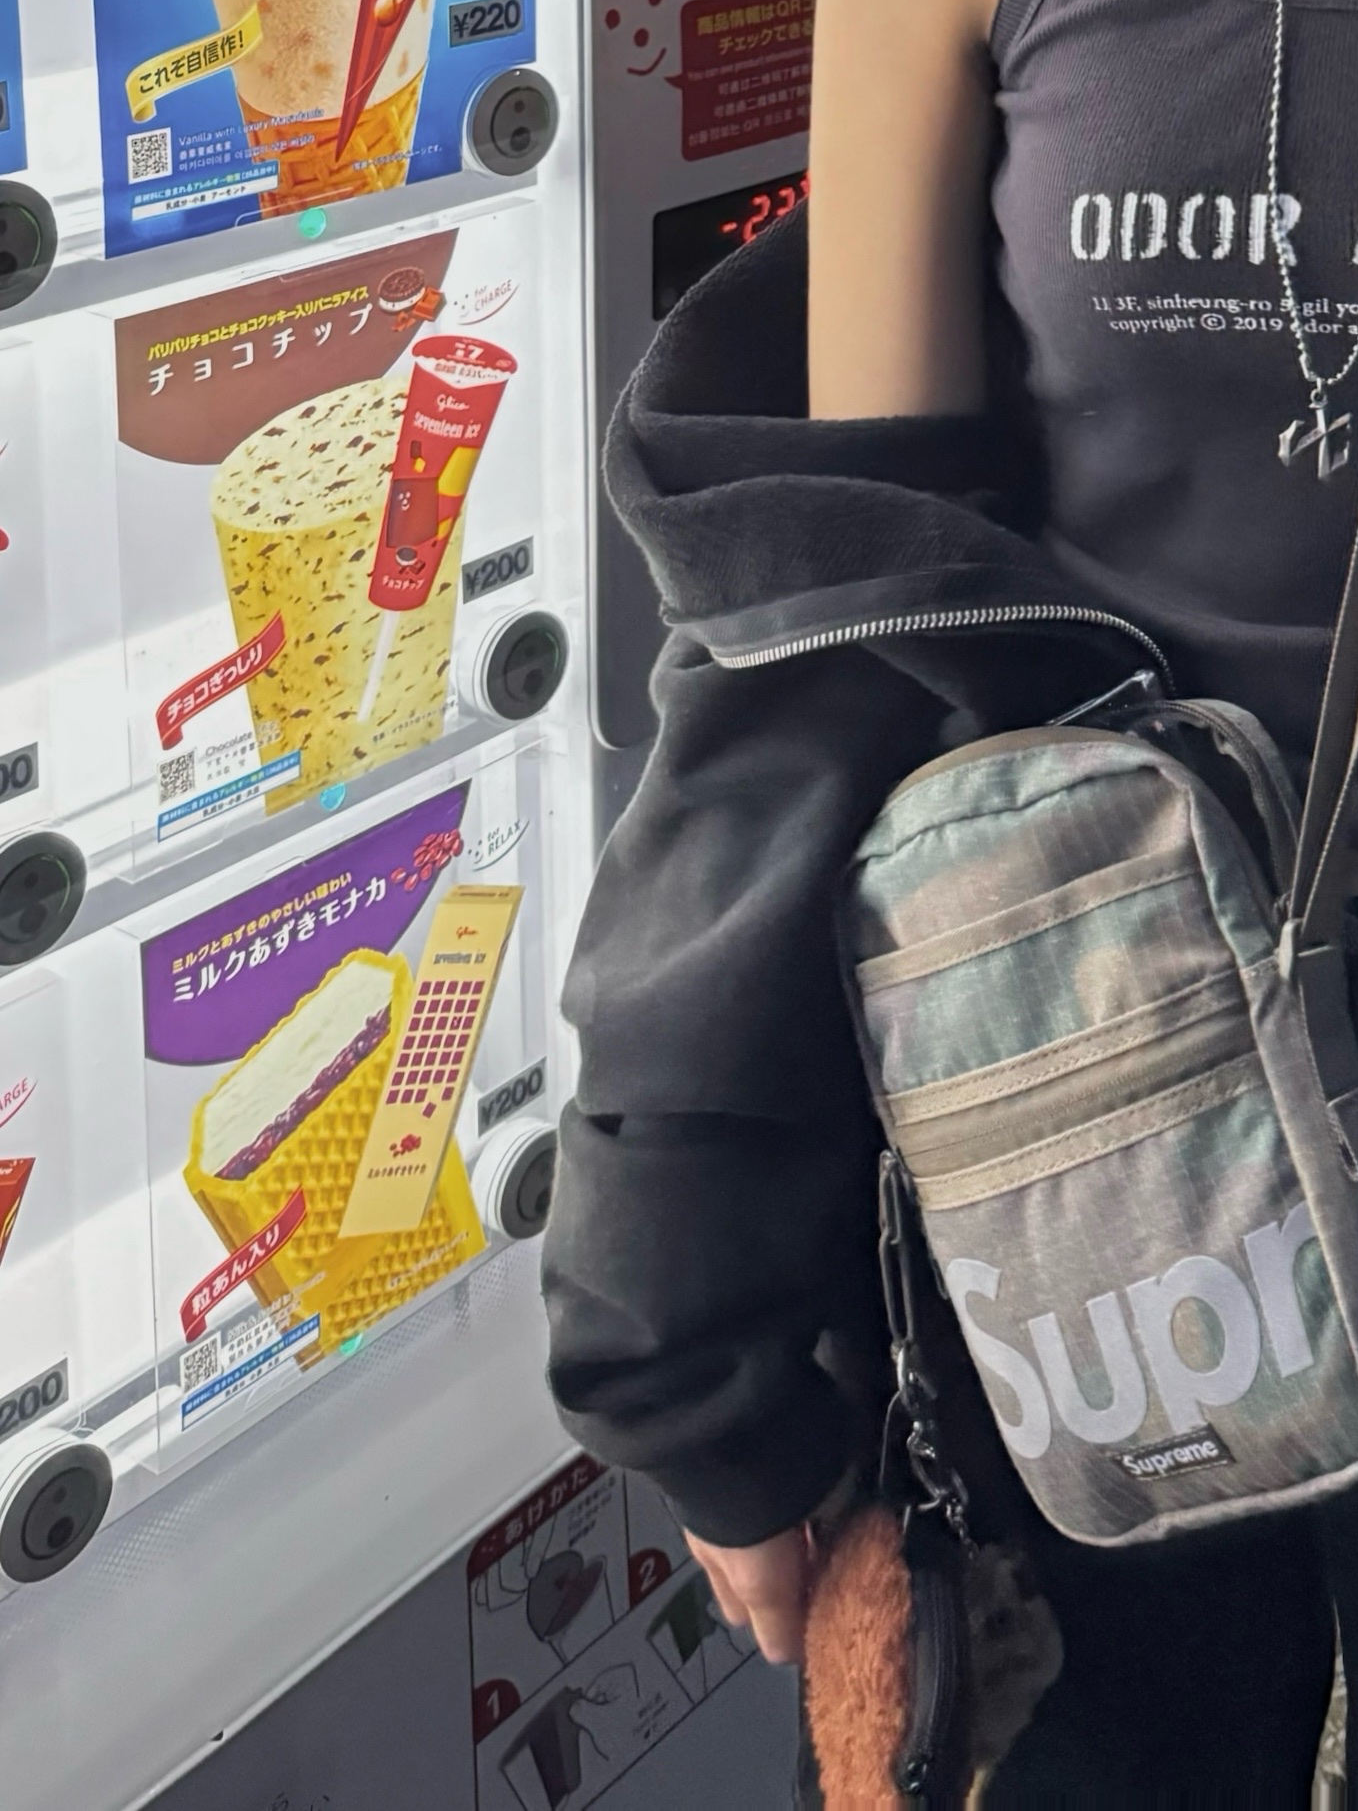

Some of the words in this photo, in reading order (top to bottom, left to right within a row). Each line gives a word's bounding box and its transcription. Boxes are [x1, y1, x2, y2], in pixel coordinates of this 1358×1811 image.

[453, 0, 521, 38] ¥220
[139, 30, 245, 94] これぞ自信作!
[179, 131, 213, 146] Vanilla
[215, 127, 235, 139] with
[1071, 191, 1300, 267] ODOR
[474, 285, 487, 299] for
[474, 279, 513, 312] CHARGE
[1116, 296, 1142, 313] 3F,
[1147, 294, 1272, 313] sinheung-ro
[148, 285, 370, 362] パリパリチョコとチョコクッキー入りバニラアイス
[1109, 315, 1197, 334] copyright
[1232, 317, 1284, 332] 2019
[147, 303, 373, 396] チョコチップ
[437, 394, 470, 411] Glico
[413, 411, 464, 439] seventeen
[465, 419, 480, 439] ice
[466, 544, 530, 597] ¥200
[167, 642, 263, 724] チョコぎっしり
[205, 731, 253, 757] Chocolate
[487, 829, 500, 842] for
[488, 820, 522, 856] RELAX
[171, 871, 353, 976] ミルクとあずきのやさしい味わい
[172, 875, 388, 1003] ミルクあずきモナカ
[480, 1065, 545, 1127] ¥200
[191, 1223, 281, 1316] 粒あん入り
[1122, 1438, 1222, 1476] Supreme
[504, 1466, 589, 1541] あけかた
[639, 1556, 658, 1592] 2
[486, 1689, 501, 1722] 1
